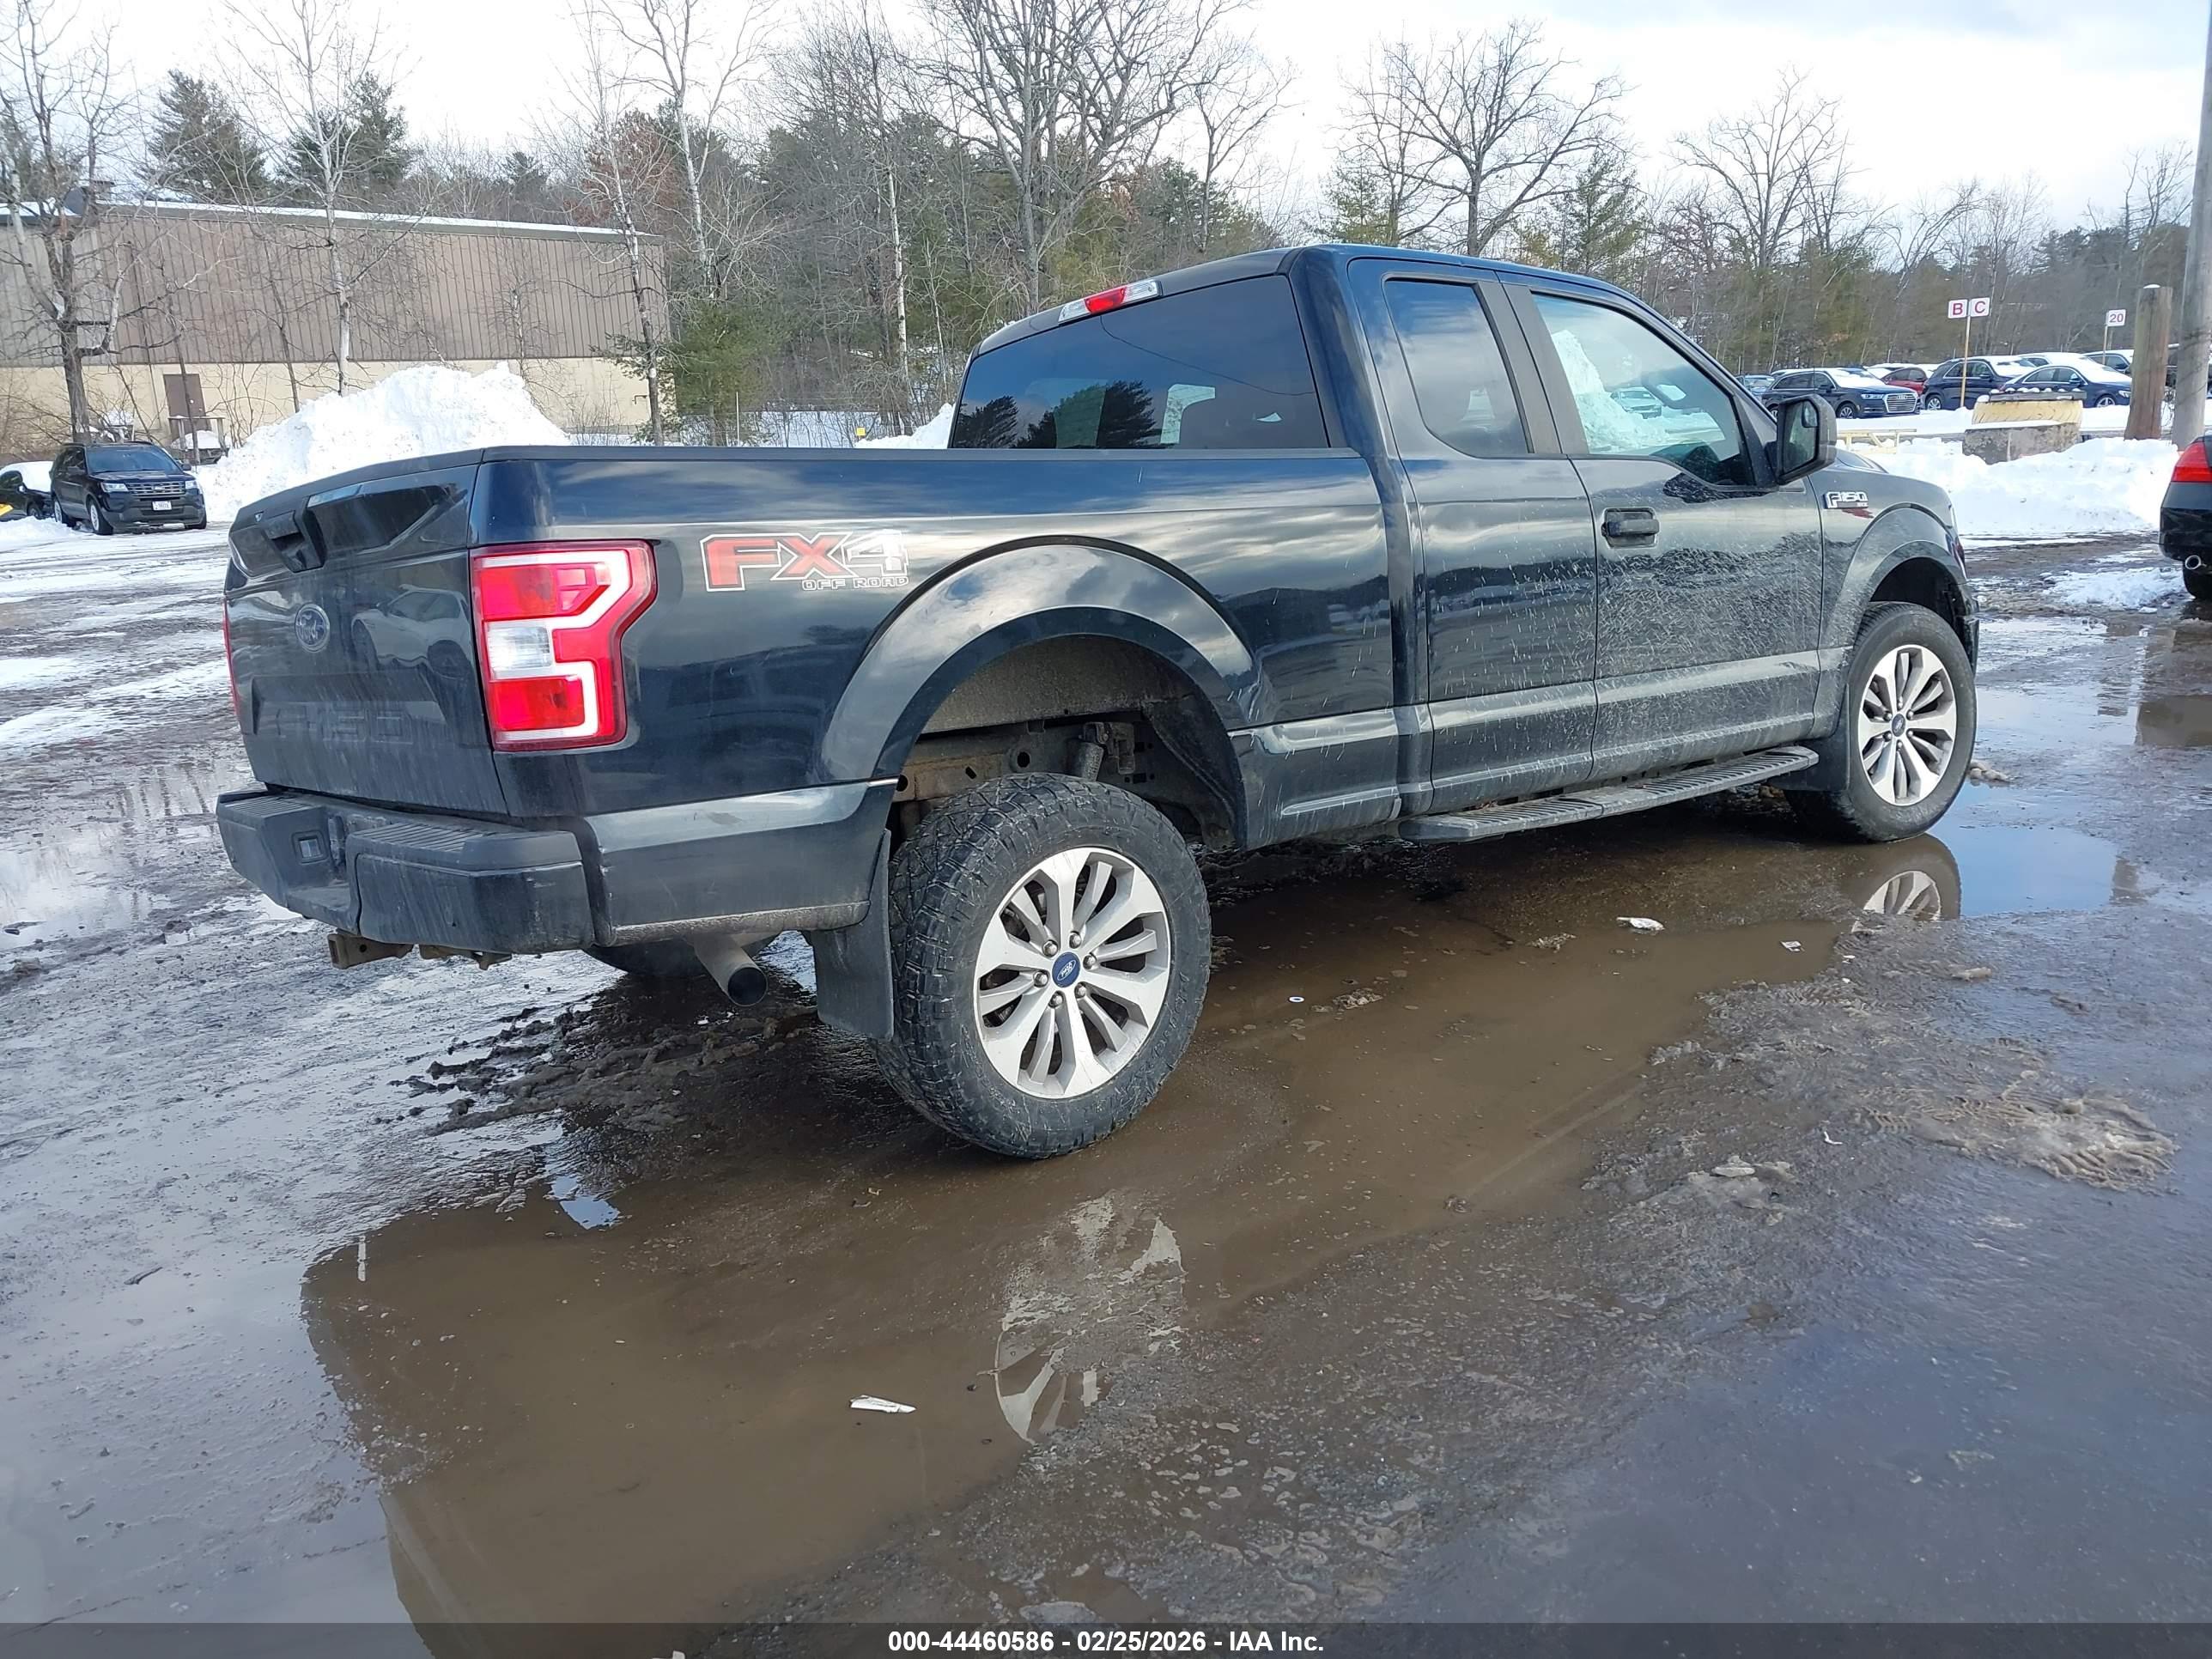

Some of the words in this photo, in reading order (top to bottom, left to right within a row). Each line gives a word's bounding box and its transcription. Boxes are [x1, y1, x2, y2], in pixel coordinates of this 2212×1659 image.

[1953, 303, 1963, 315] B
[1975, 301, 1986, 313] C
[2109, 313, 2124, 323] 20
[700, 529, 909, 592] FX4
[802, 578, 847, 591] OFF
[854, 576, 909, 589] ROAD
